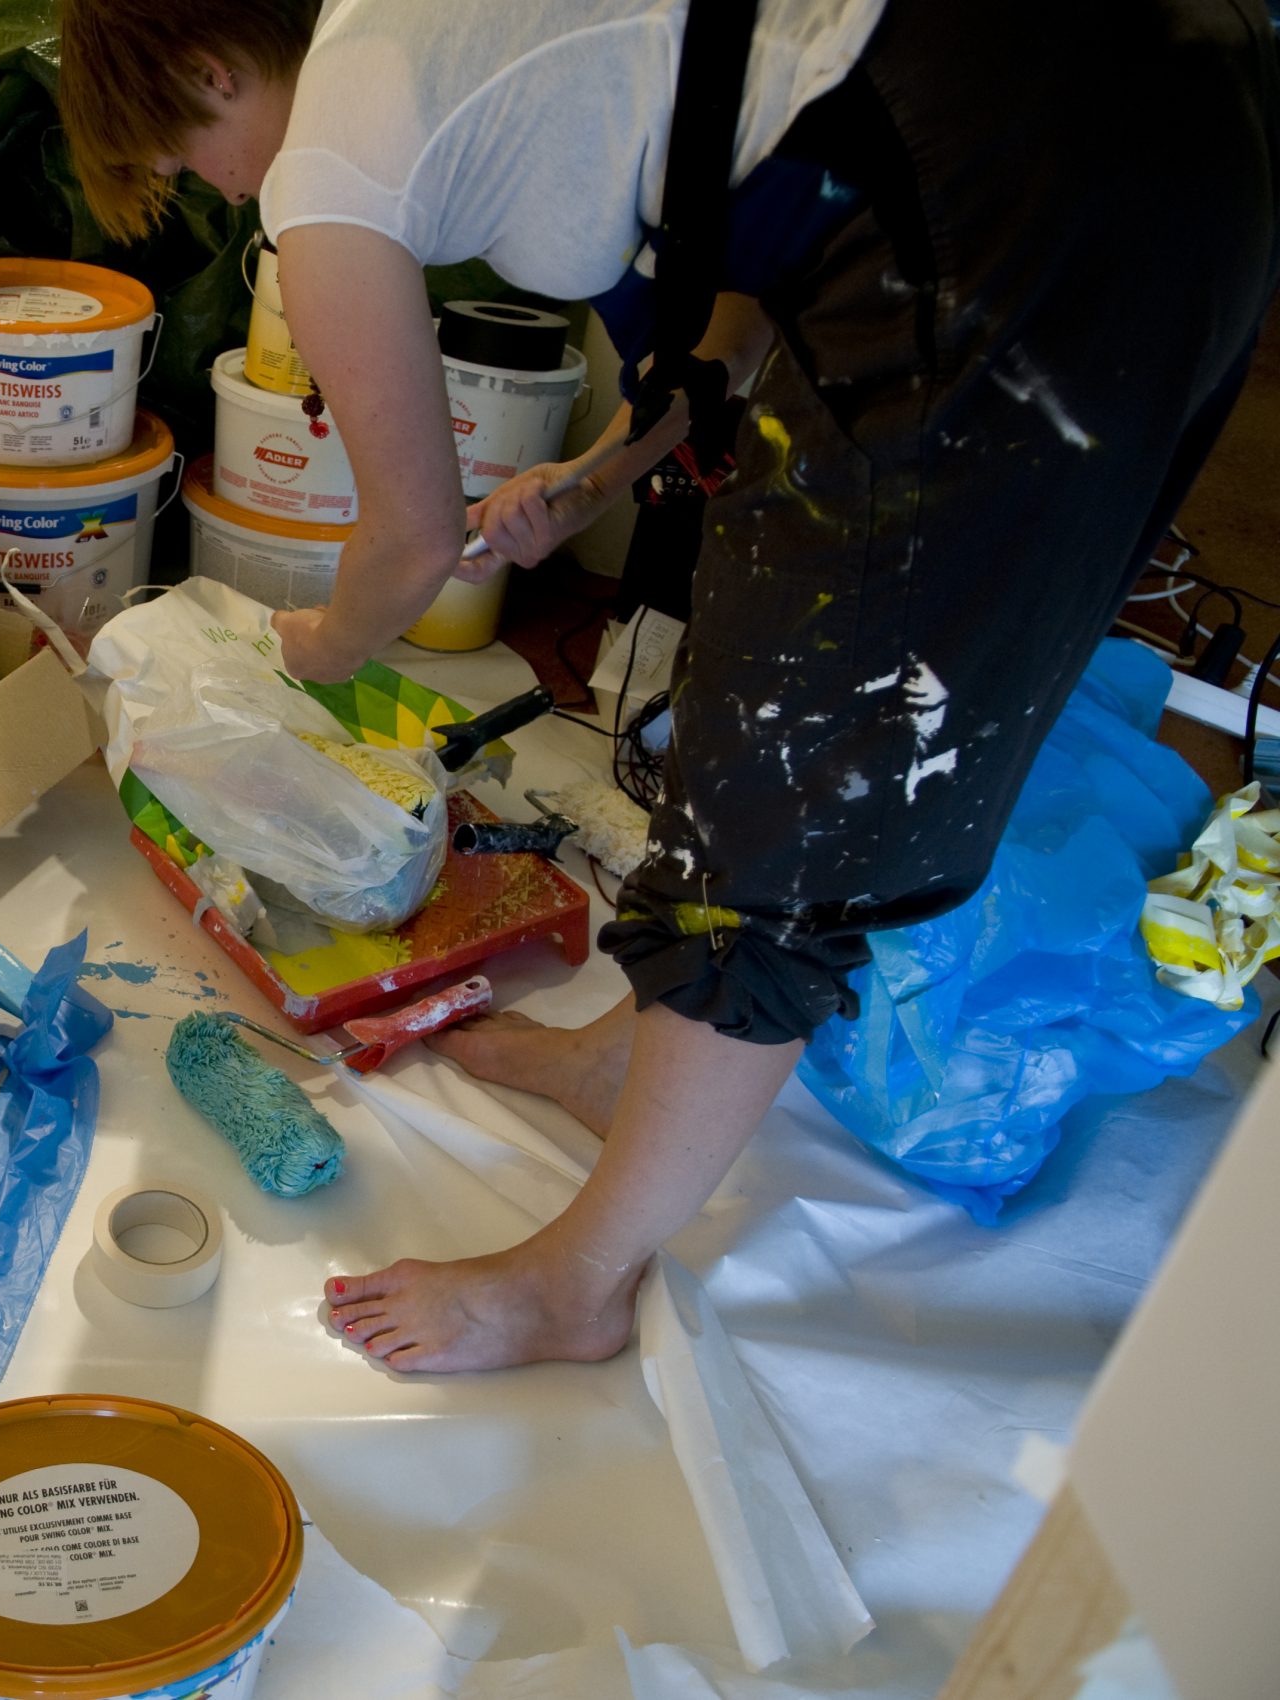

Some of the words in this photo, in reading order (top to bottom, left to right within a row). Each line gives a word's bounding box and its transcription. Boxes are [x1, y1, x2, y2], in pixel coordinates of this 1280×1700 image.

[12, 399, 41, 409] BANQUISE
[17, 410, 39, 419] ARTICO
[452, 420, 470, 432] LER
[264, 450, 303, 467] ADLER
[14, 571, 50, 581] BANQUISE
[200, 626, 238, 644] We
[22, 1489, 39, 1501] ALS
[41, 1481, 96, 1498] BASISFARBE
[99, 1477, 117, 1491] FÜR
[57, 1498, 76, 1510] MIX
[78, 1491, 140, 1507] VERWENDEN.
[29, 1516, 85, 1532] EXCLUSIVEMENT
[86, 1514, 113, 1524] COMME
[114, 1511, 132, 1521] BASE
[19, 1533, 39, 1544] POUR
[41, 1529, 66, 1541] SWING
[96, 1524, 114, 1533] MIX.
[61, 1541, 81, 1551] COME
[83, 1538, 111, 1550] COLORE
[112, 1537, 121, 1546] DI
[122, 1535, 139, 1545] BASE
[98, 1550, 116, 1559] MIX.
